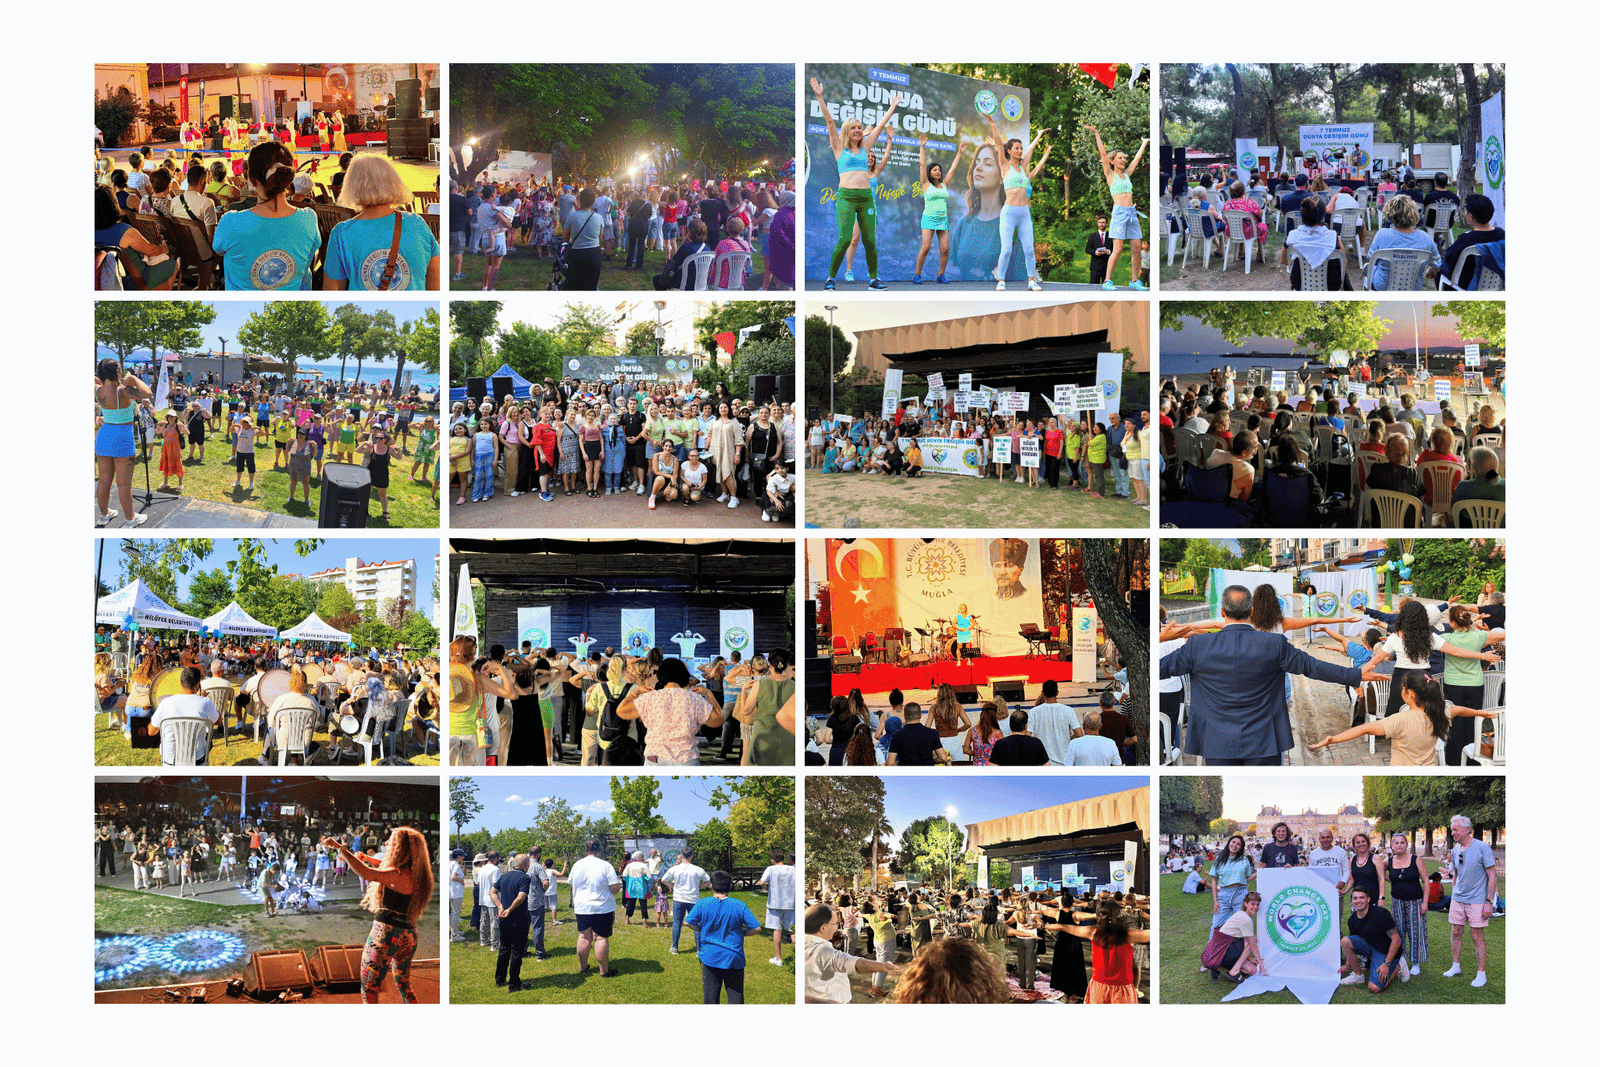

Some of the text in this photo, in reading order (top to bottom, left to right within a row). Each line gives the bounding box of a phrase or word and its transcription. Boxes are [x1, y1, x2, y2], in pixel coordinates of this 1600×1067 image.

[878, 71, 907, 83] TEMMUZ
[851, 81, 924, 111] DÜNYA
[810, 126, 825, 134] AÇIK
[902, 112, 957, 137] GÜNÜ
[920, 588, 954, 599] MUĞLA
[144, 614, 168, 623] NİLÜFER
[168, 618, 193, 627] BELEDİYESİ
[1267, 888, 1330, 923] WORLD CHANGE DAY
